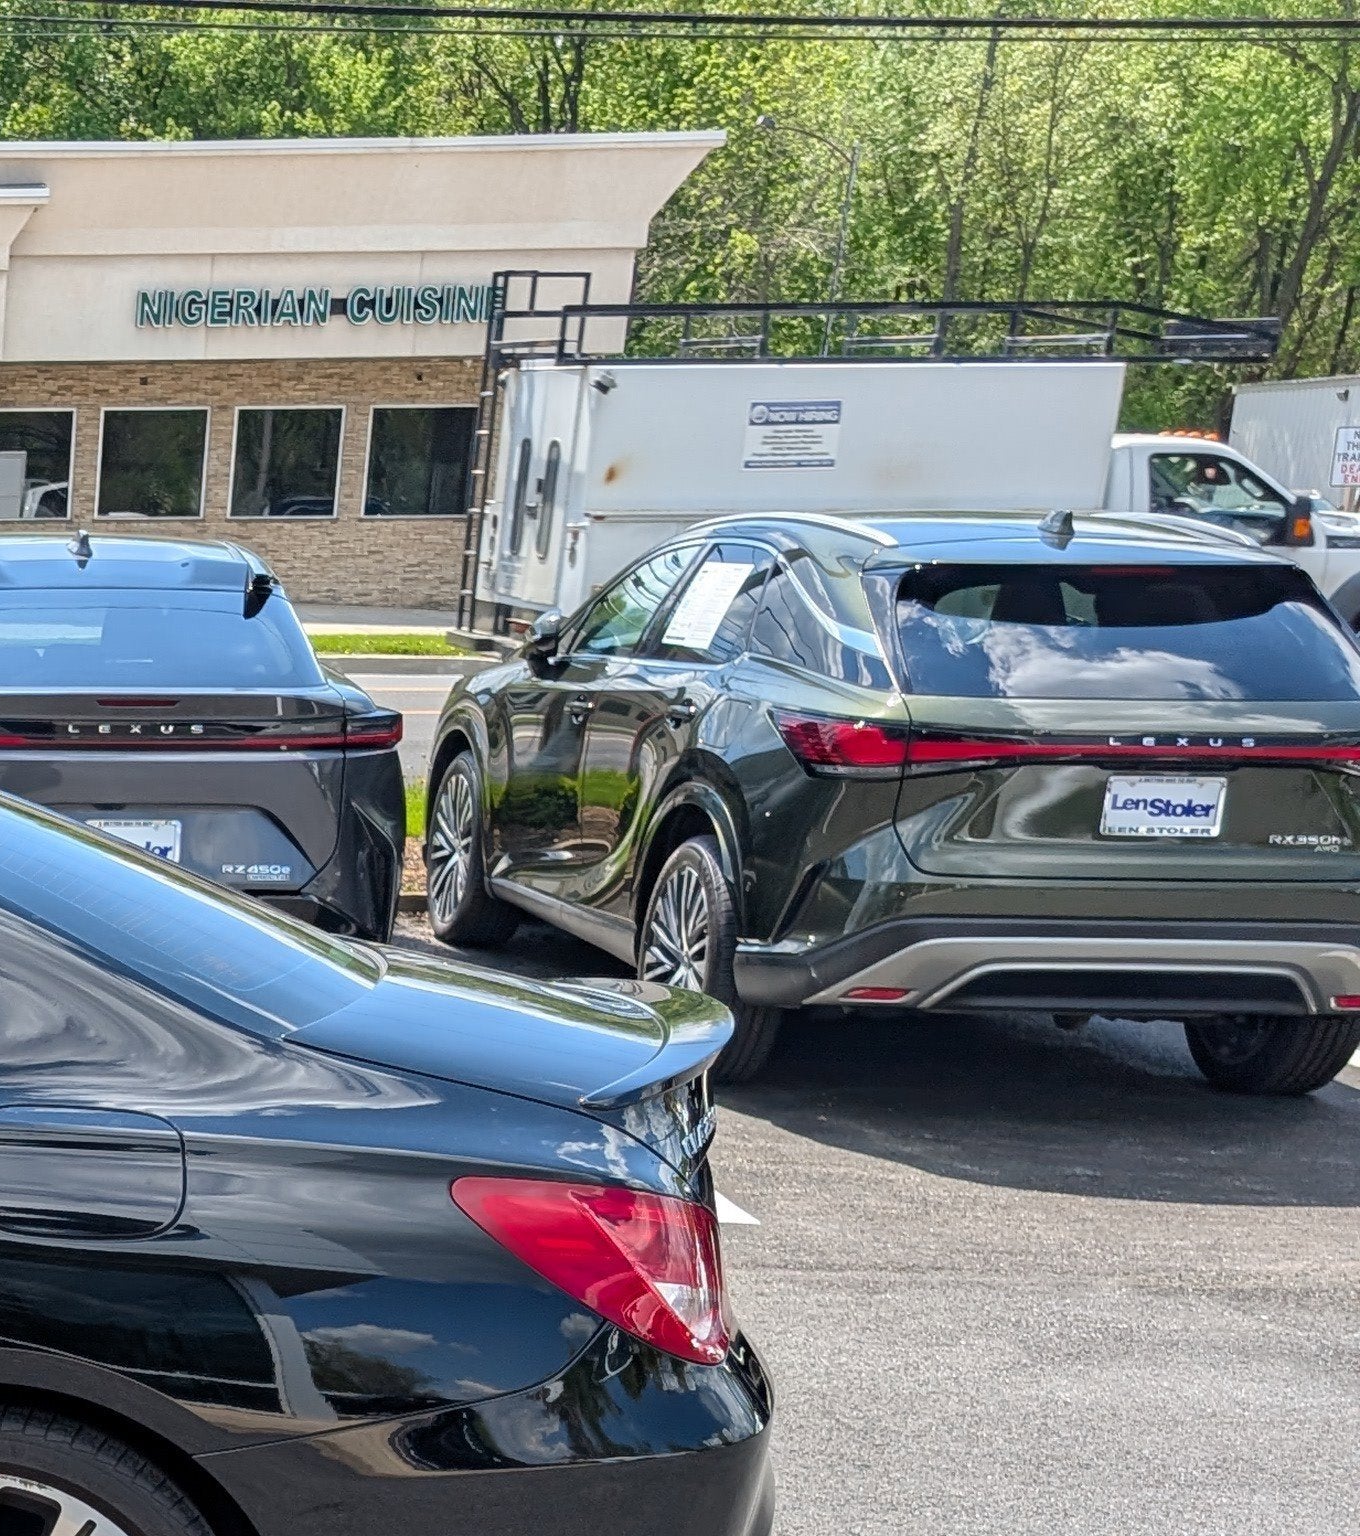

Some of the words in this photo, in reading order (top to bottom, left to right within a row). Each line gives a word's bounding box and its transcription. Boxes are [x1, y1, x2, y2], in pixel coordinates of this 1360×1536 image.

[136, 288, 331, 328] NIGERIAN
[67, 724, 204, 734] LEXUS
[1108, 736, 1255, 748] LEXUS
[1108, 826, 1140, 834] LEN
[1146, 827, 1212, 835] STOLER
